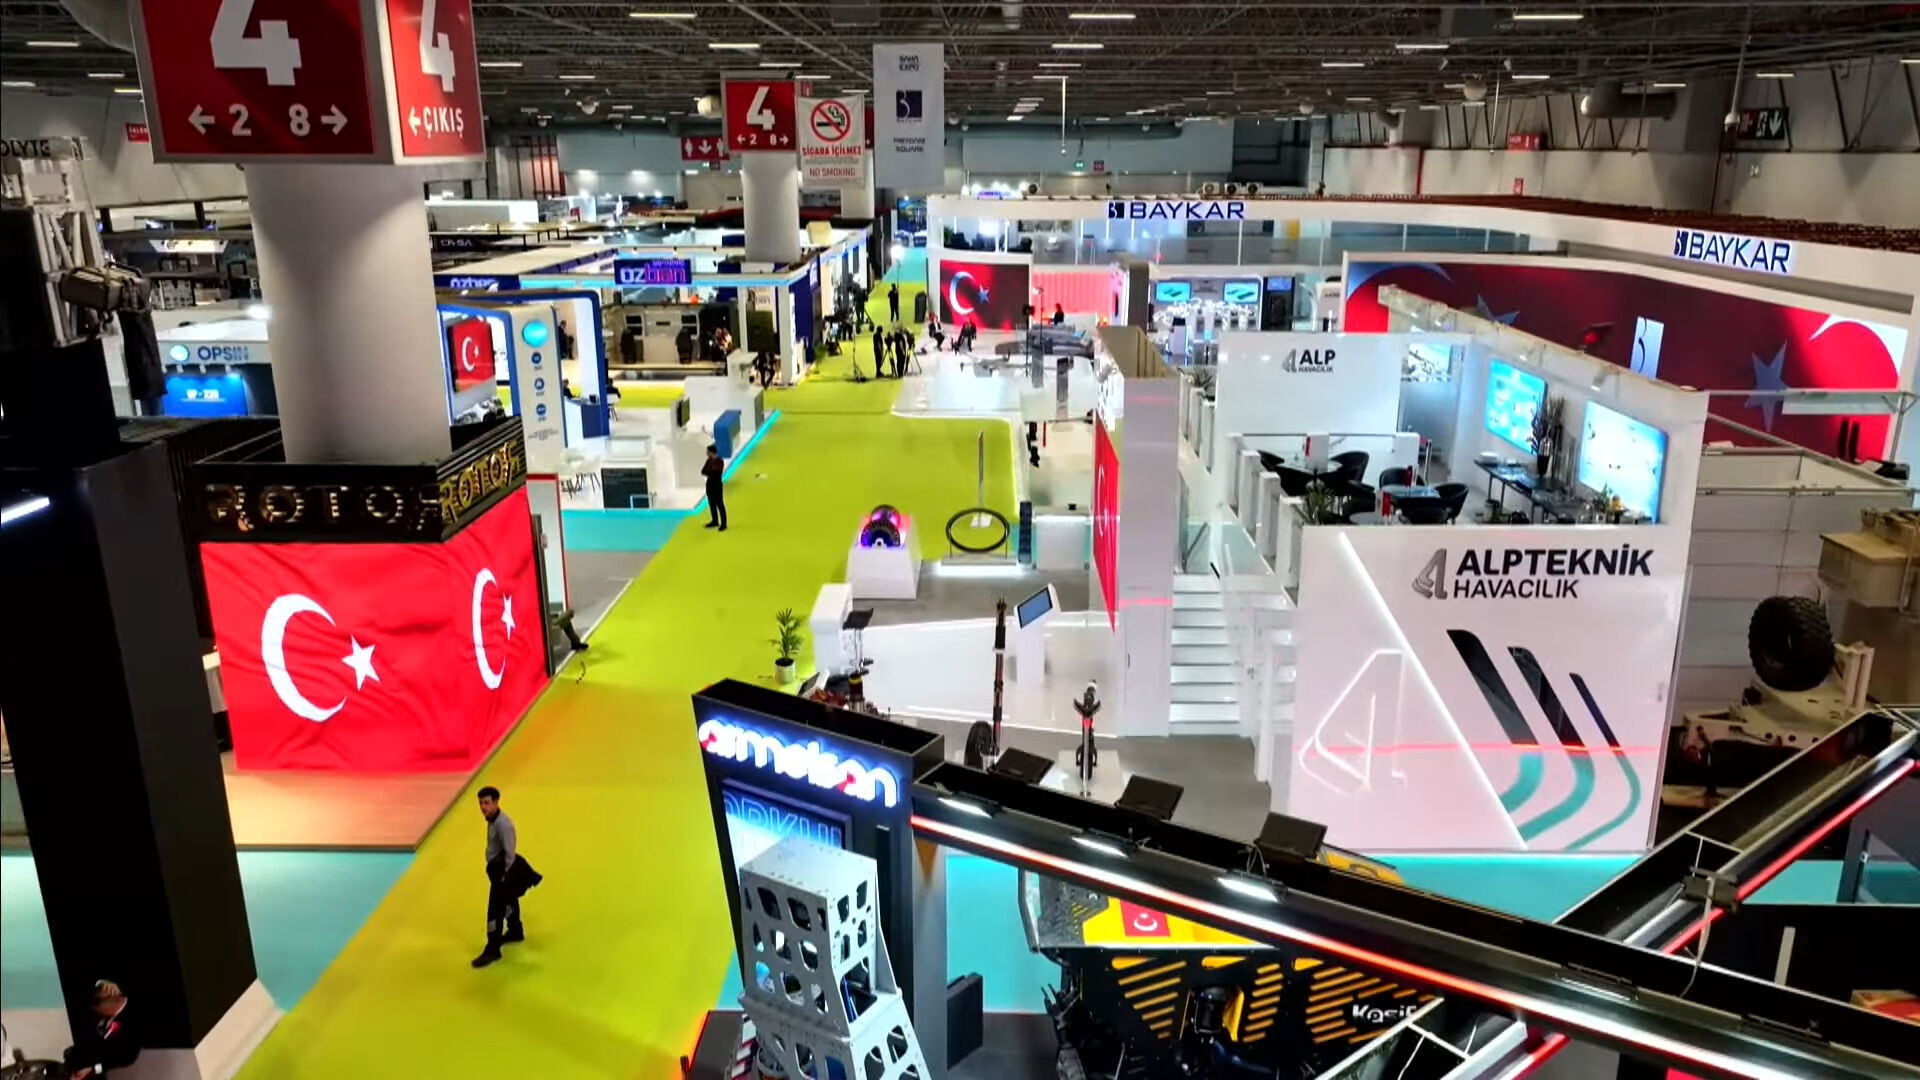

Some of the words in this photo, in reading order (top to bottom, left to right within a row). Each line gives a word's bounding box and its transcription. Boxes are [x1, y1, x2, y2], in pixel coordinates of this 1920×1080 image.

[210, 0, 303, 86] 4
[420, 0, 455, 92] 4
[229, 104, 252, 136] 2
[288, 104, 311, 136] 8
[423, 108, 464, 138] ÇIKIŞ
[746, 86, 775, 131] 4
[749, 133, 758, 145] 2
[769, 133, 777, 145] 8
[810, 168, 820, 176] NO
[1130, 202, 1244, 219] BAYKAR
[1689, 232, 1790, 273] BAYKAR
[1300, 349, 1336, 365] ALP
[1456, 544, 1654, 576] ALPTEKNİK
[1454, 579, 1580, 598] HAVACILIK
